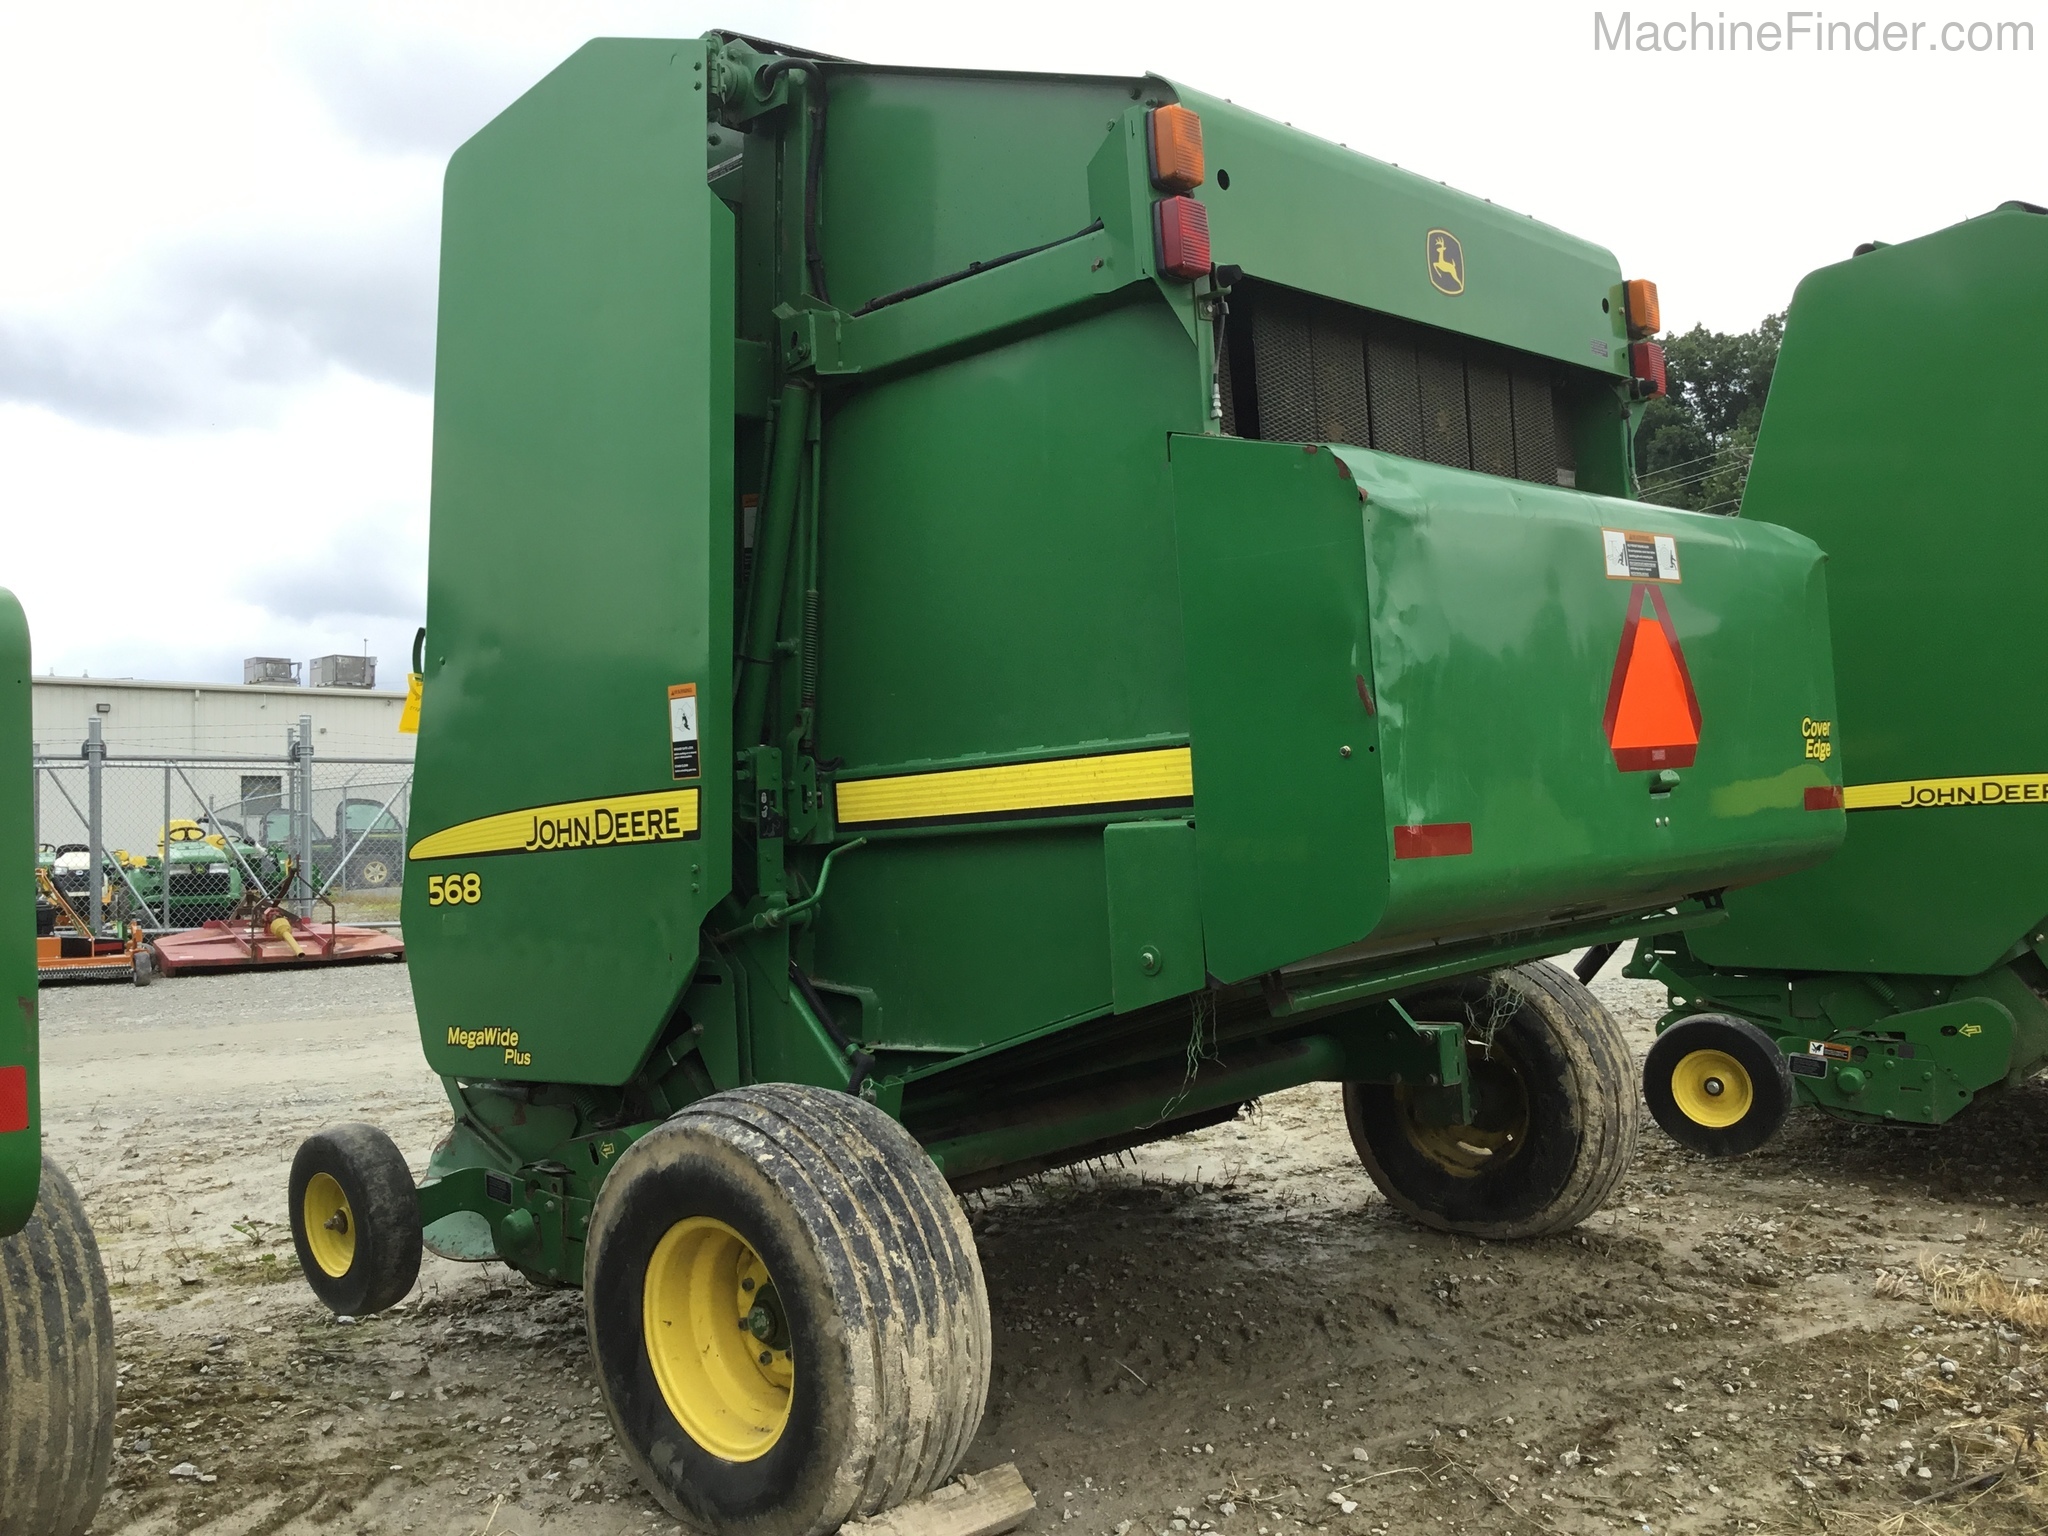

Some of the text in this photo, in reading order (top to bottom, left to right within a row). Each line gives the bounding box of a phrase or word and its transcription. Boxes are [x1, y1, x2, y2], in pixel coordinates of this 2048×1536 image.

[1801, 717, 1831, 738] Cover
[1805, 738, 1832, 762] Edge
[1901, 786, 1976, 805] JOHN
[525, 807, 681, 847] JOHN DEERE
[428, 872, 482, 906] 568
[447, 1026, 519, 1049] MegaWide
[504, 1048, 531, 1065] Plus
